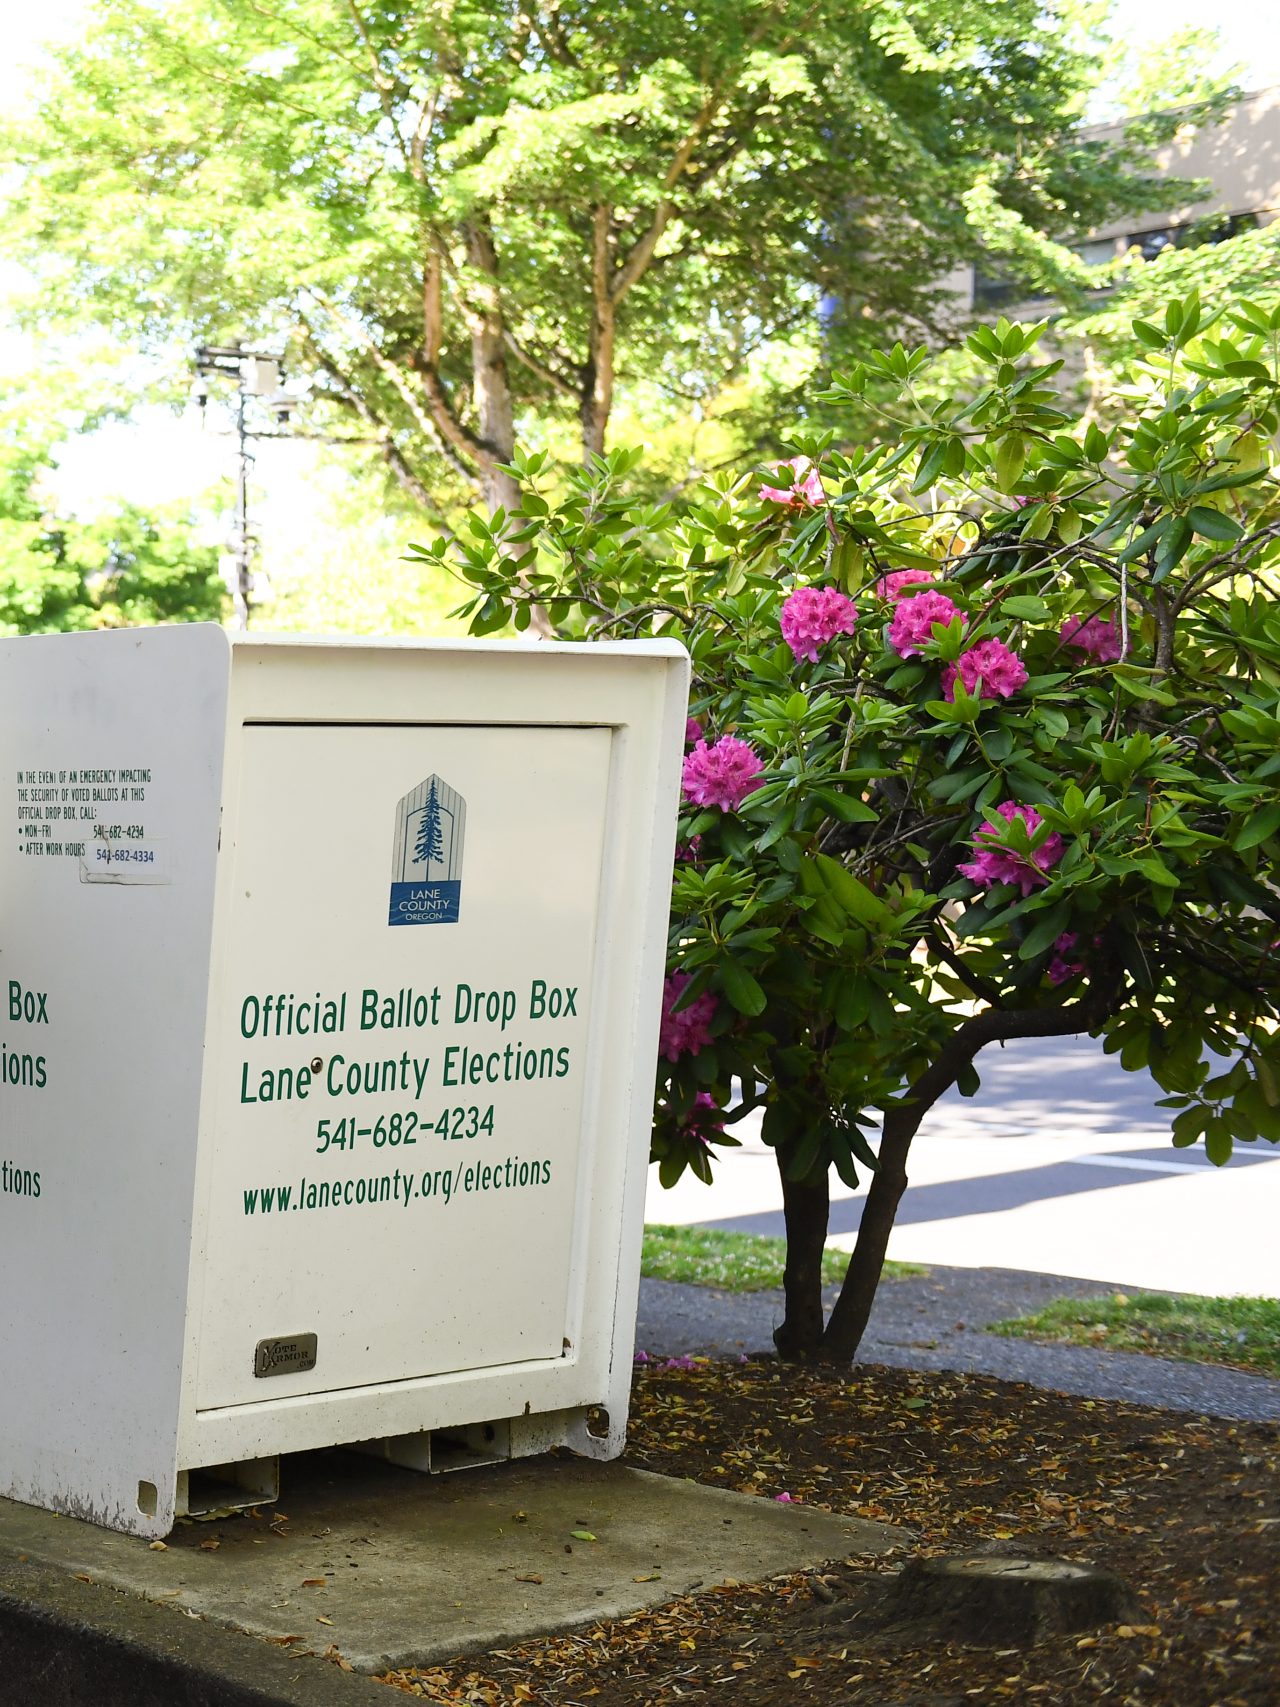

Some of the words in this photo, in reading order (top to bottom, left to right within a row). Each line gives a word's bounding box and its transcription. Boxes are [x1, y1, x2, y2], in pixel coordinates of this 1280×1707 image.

[17, 771, 23, 784] IN
[26, 771, 36, 784] THE
[59, 770, 67, 784] OF
[69, 770, 77, 783] AN
[80, 770, 116, 783] EMERGENCY
[119, 769, 151, 783] IMPACTING
[18, 788, 28, 801] THE
[30, 788, 58, 801] SECURITY
[62, 788, 69, 801] OF
[71, 788, 90, 801] VOTED
[92, 788, 118, 801] BALLOTS
[121, 788, 129, 801] AT
[131, 788, 145, 801] THIS
[18, 806, 43, 819] OFFICIAL
[45, 806, 61, 819] DROP
[64, 806, 78, 821] BOX,
[80, 806, 97, 819] CALL:
[25, 825, 51, 837] MON-FRI
[93, 825, 144, 838] 541-682-4234
[26, 843, 43, 856] AFTER
[46, 843, 62, 856] WORK
[65, 843, 86, 857] HOURS
[96, 849, 154, 863] 541-682-4334
[411, 889, 441, 900] LANE
[399, 900, 450, 912] COUNTY
[405, 912, 443, 921] OREGON
[9, 980, 49, 1024] Box
[240, 992, 347, 1039] Official
[360, 986, 441, 1030] Ballot
[454, 983, 517, 1031] Drop
[530, 979, 579, 1019] Box
[240, 1062, 312, 1104] Lane
[327, 1050, 430, 1100] County
[443, 1041, 570, 1087] Elections
[315, 1105, 495, 1154] 541-682-4234
[243, 1156, 552, 1215] www.lanecounty.org/elections
